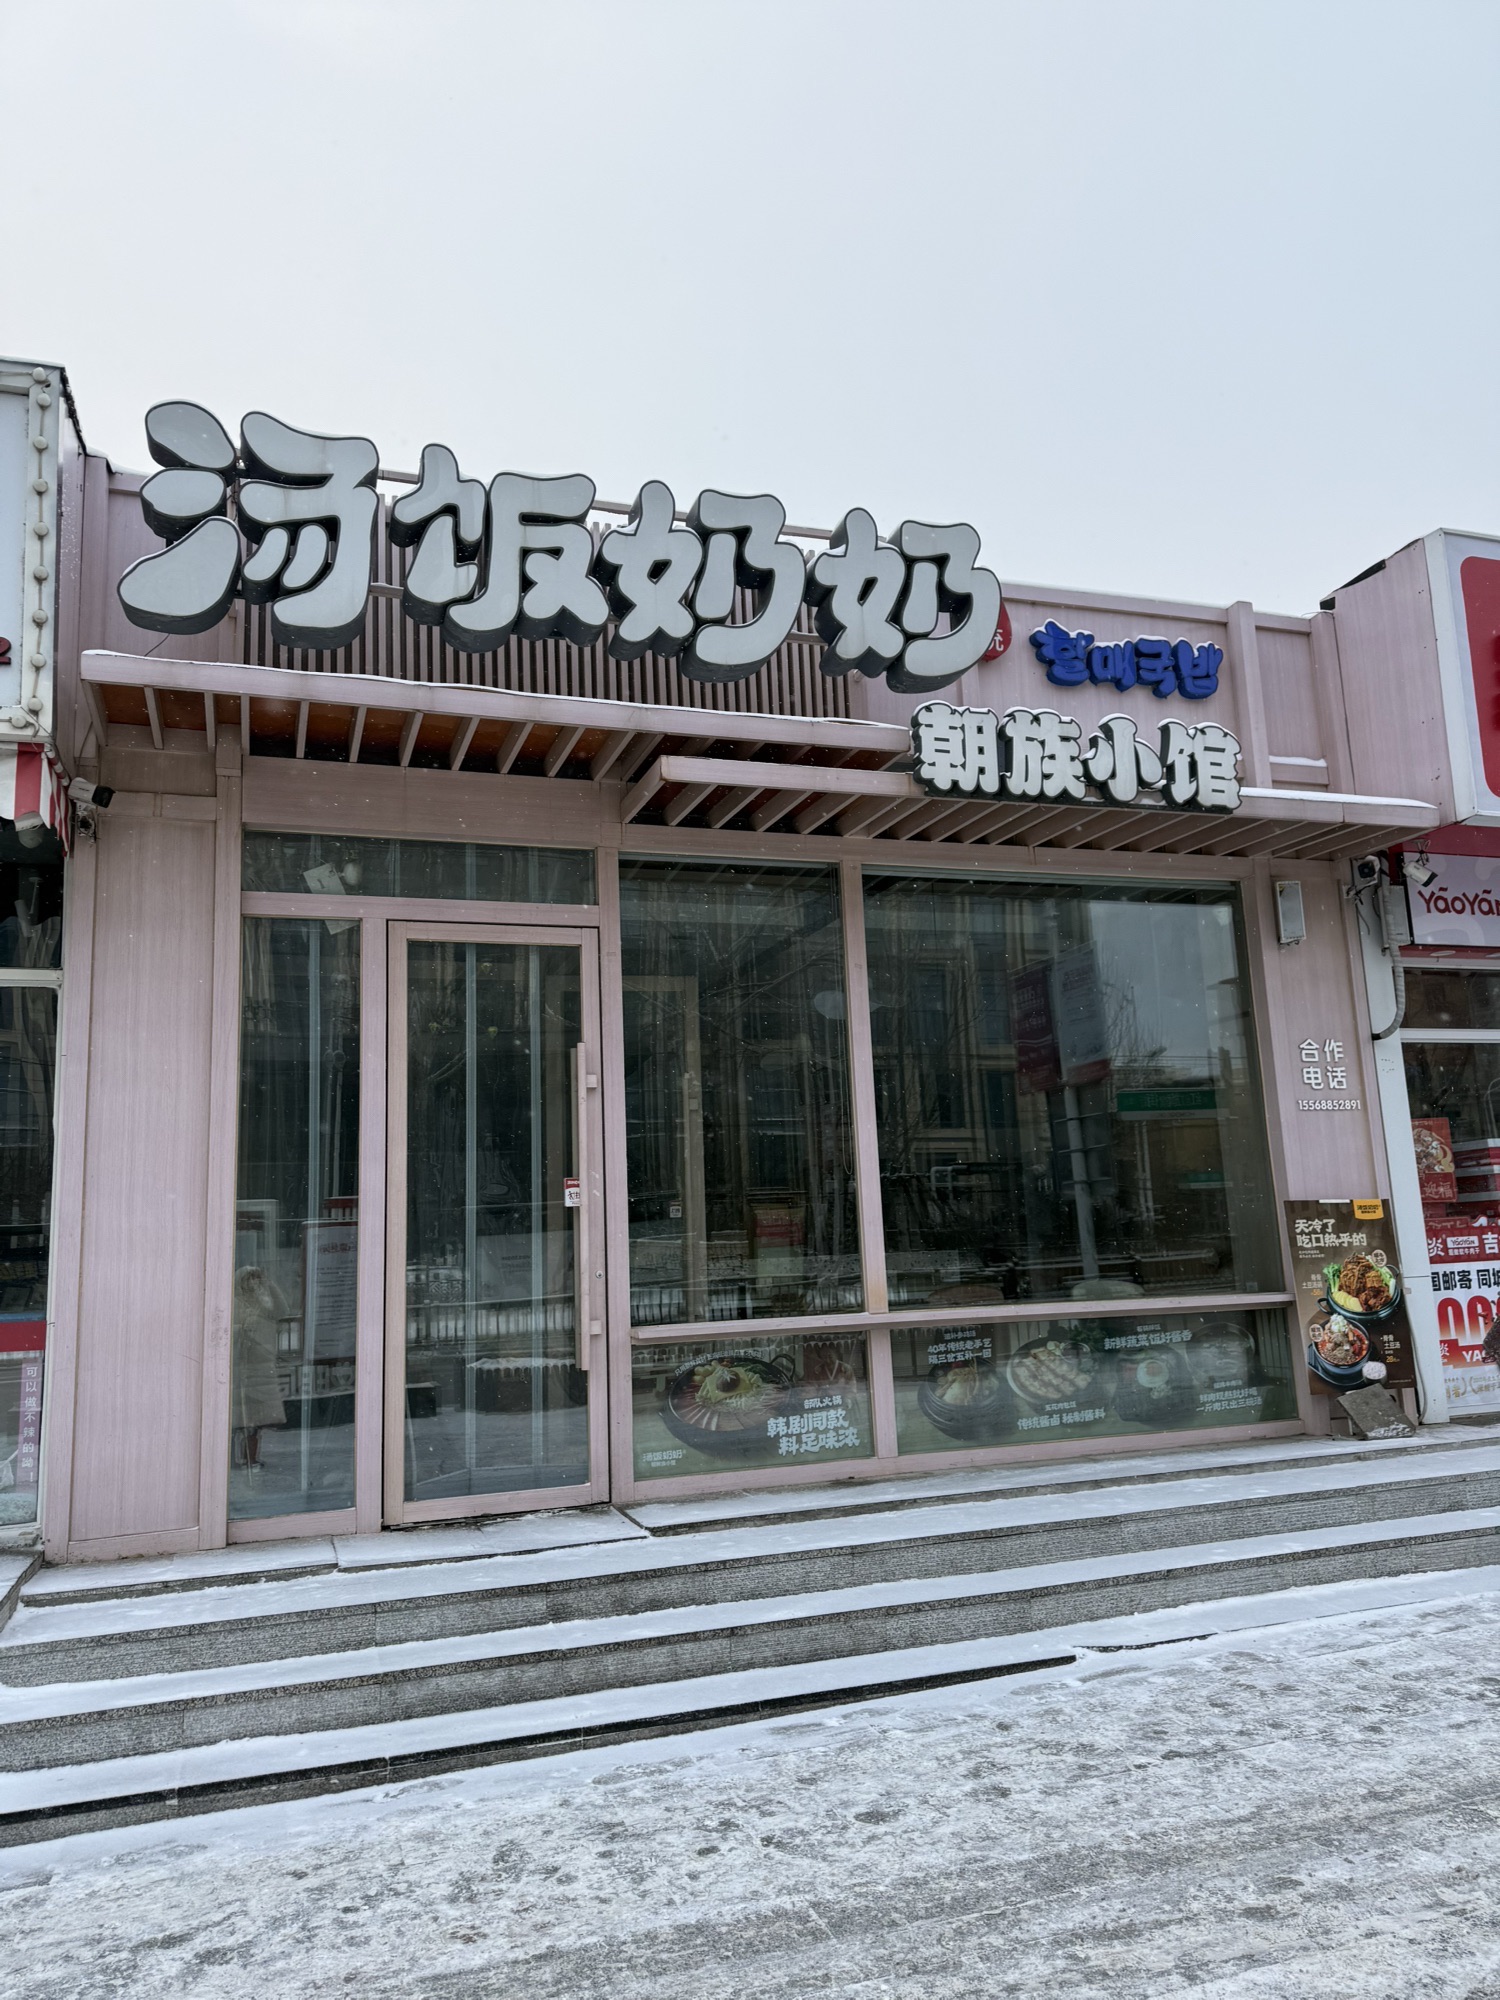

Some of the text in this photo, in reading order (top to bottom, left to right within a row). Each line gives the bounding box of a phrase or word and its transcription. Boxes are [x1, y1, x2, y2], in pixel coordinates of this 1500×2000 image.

[118, 399, 1001, 693] 汤饭奶奶
[911, 701, 1242, 811] 朝族小馆
[1299, 1039, 1344, 1062] 合作
[1303, 1066, 1347, 1089] 电话
[1298, 1100, 1361, 1110] 15568852891
[1295, 1219, 1335, 1233] 天冷了
[1297, 1232, 1367, 1247] 吃口热乎的
[928, 1338, 992, 1354] 40年传统老手艺
[804, 1395, 842, 1409] 部队火锅
[767, 1408, 849, 1437] 韩剧同款
[778, 1426, 861, 1456] 料足味浓
